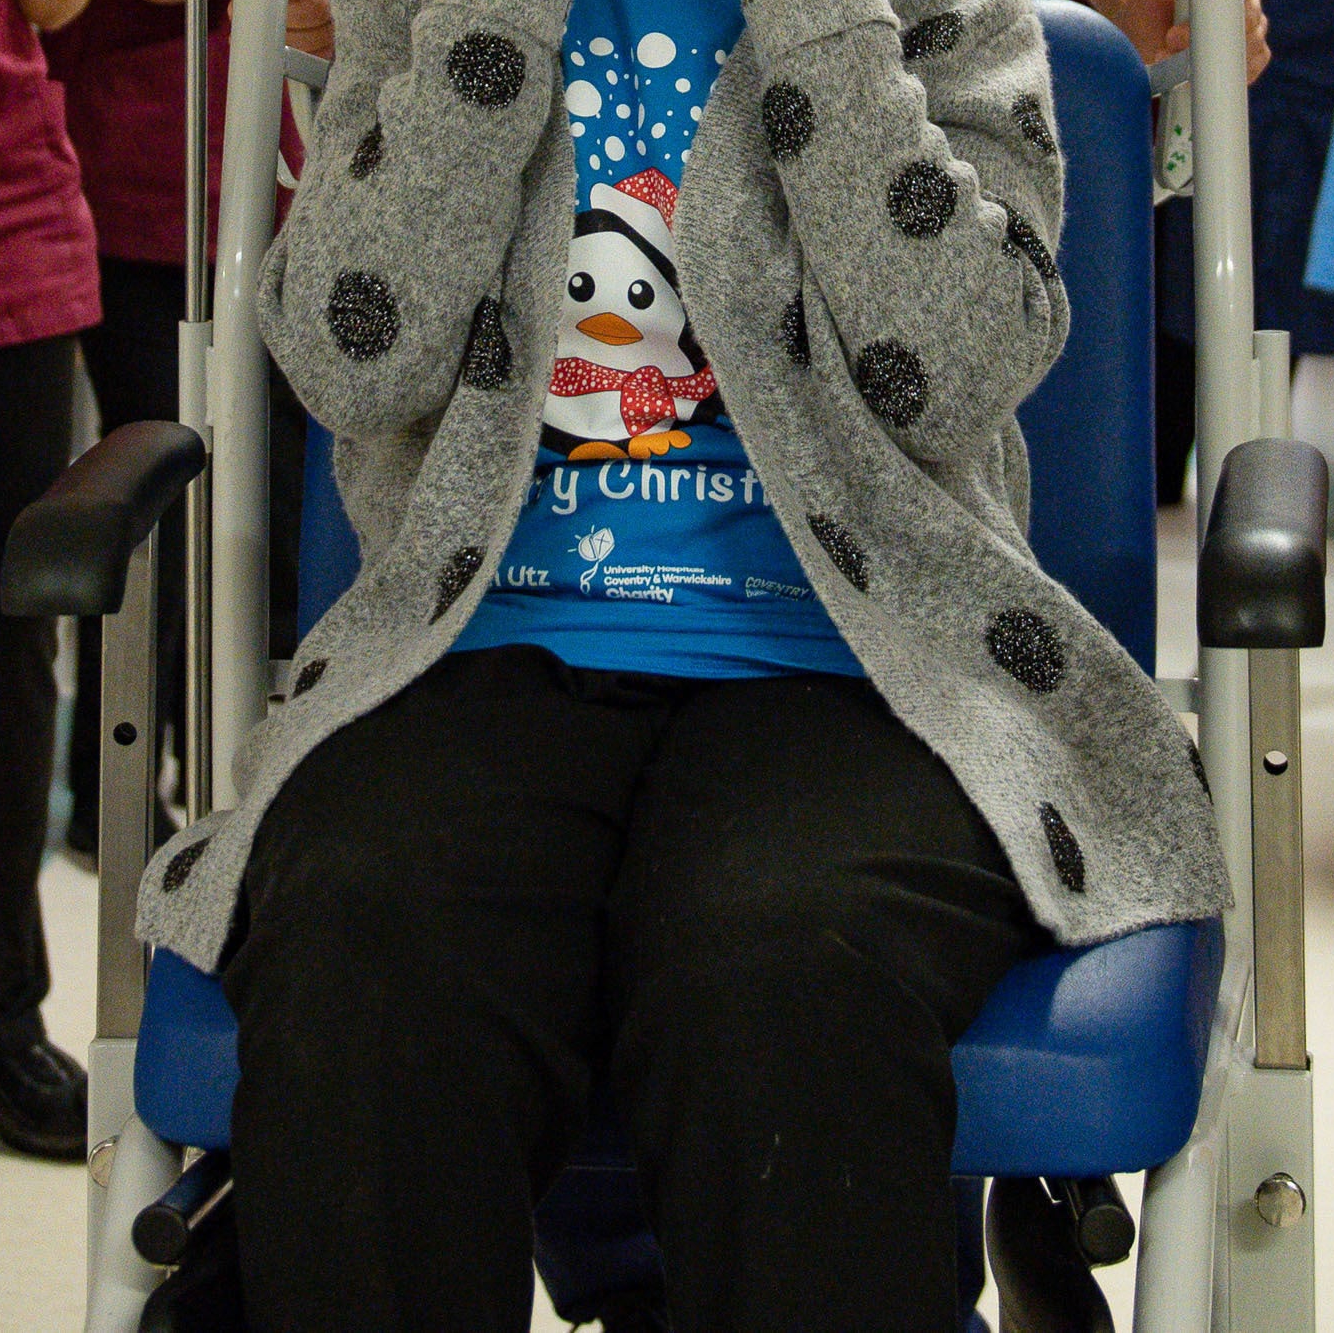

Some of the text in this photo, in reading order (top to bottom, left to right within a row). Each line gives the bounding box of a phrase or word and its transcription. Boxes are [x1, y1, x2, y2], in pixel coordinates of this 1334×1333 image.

[598, 459, 771, 507] Christ
[507, 566, 551, 587] Utz
[603, 564, 655, 575] University
[603, 573, 733, 586] Coventry & Warwickshire
[745, 576, 809, 598] COVENTRY
[605, 585, 674, 603] Charity
